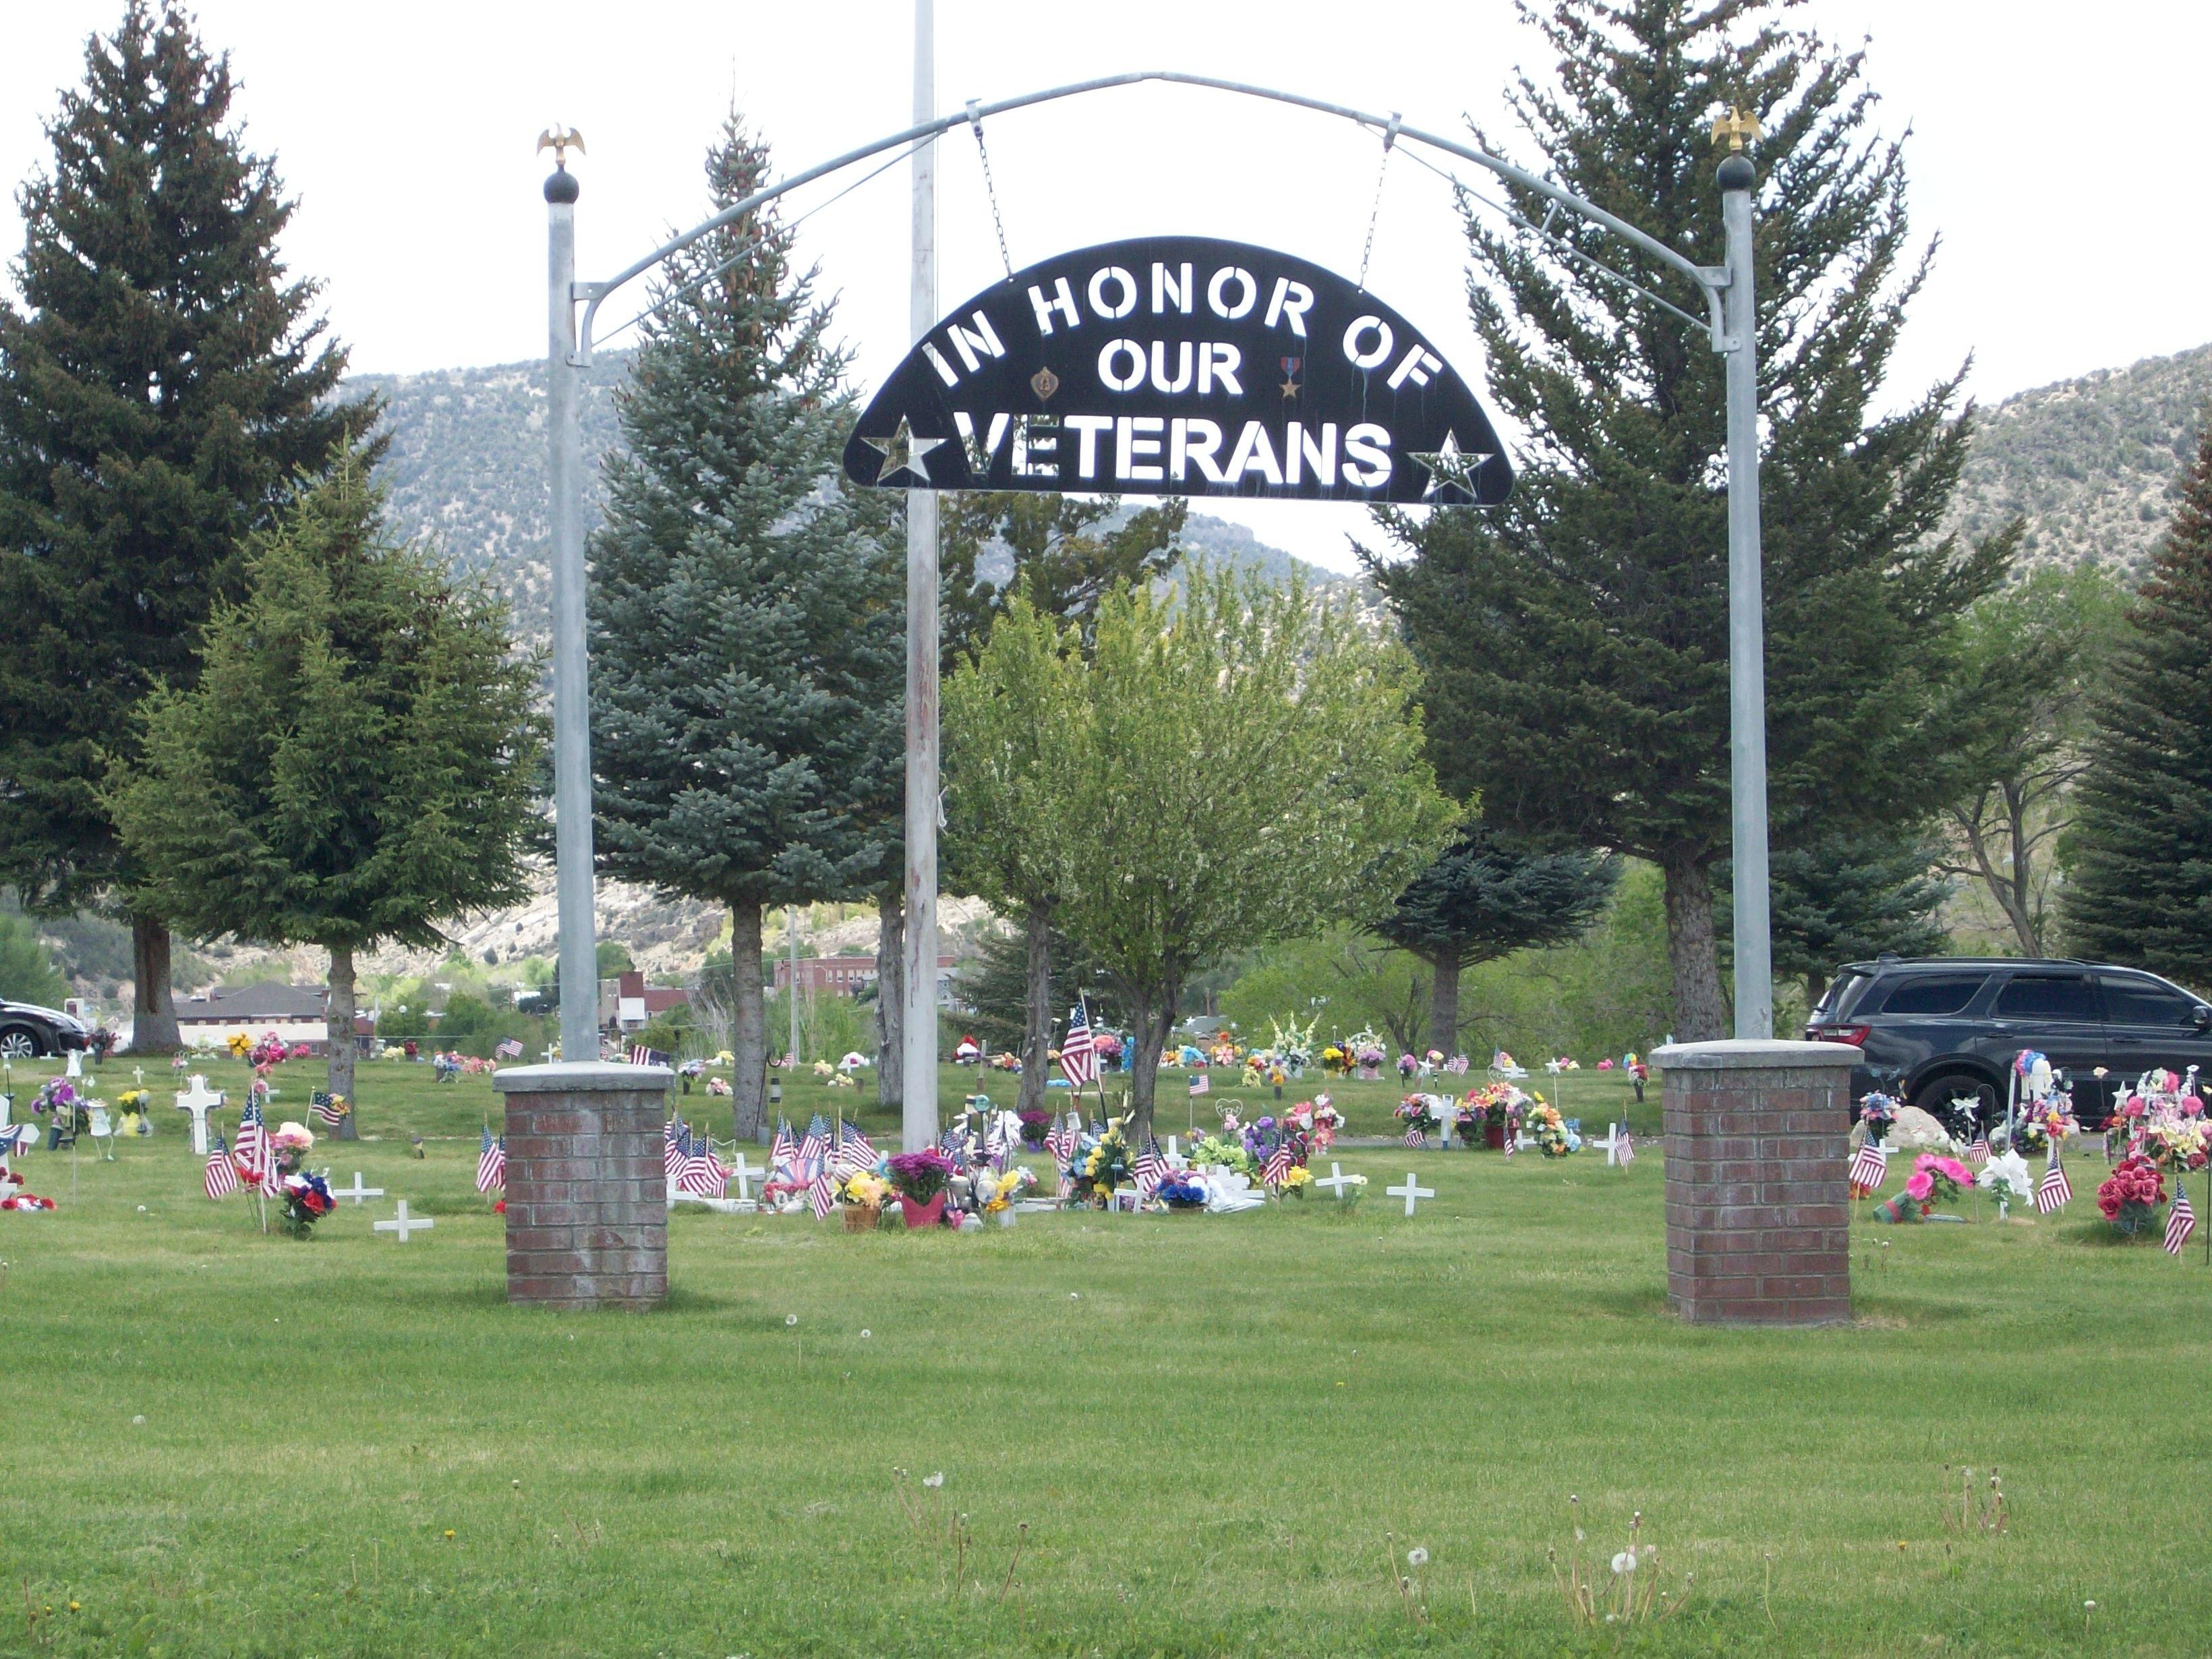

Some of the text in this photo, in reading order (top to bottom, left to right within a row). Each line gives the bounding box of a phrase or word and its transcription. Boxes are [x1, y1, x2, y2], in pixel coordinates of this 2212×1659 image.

[921, 262, 1443, 389] IN HONOR OF
[1098, 339, 1244, 395] OUR
[953, 411, 1393, 488] VETERANS
